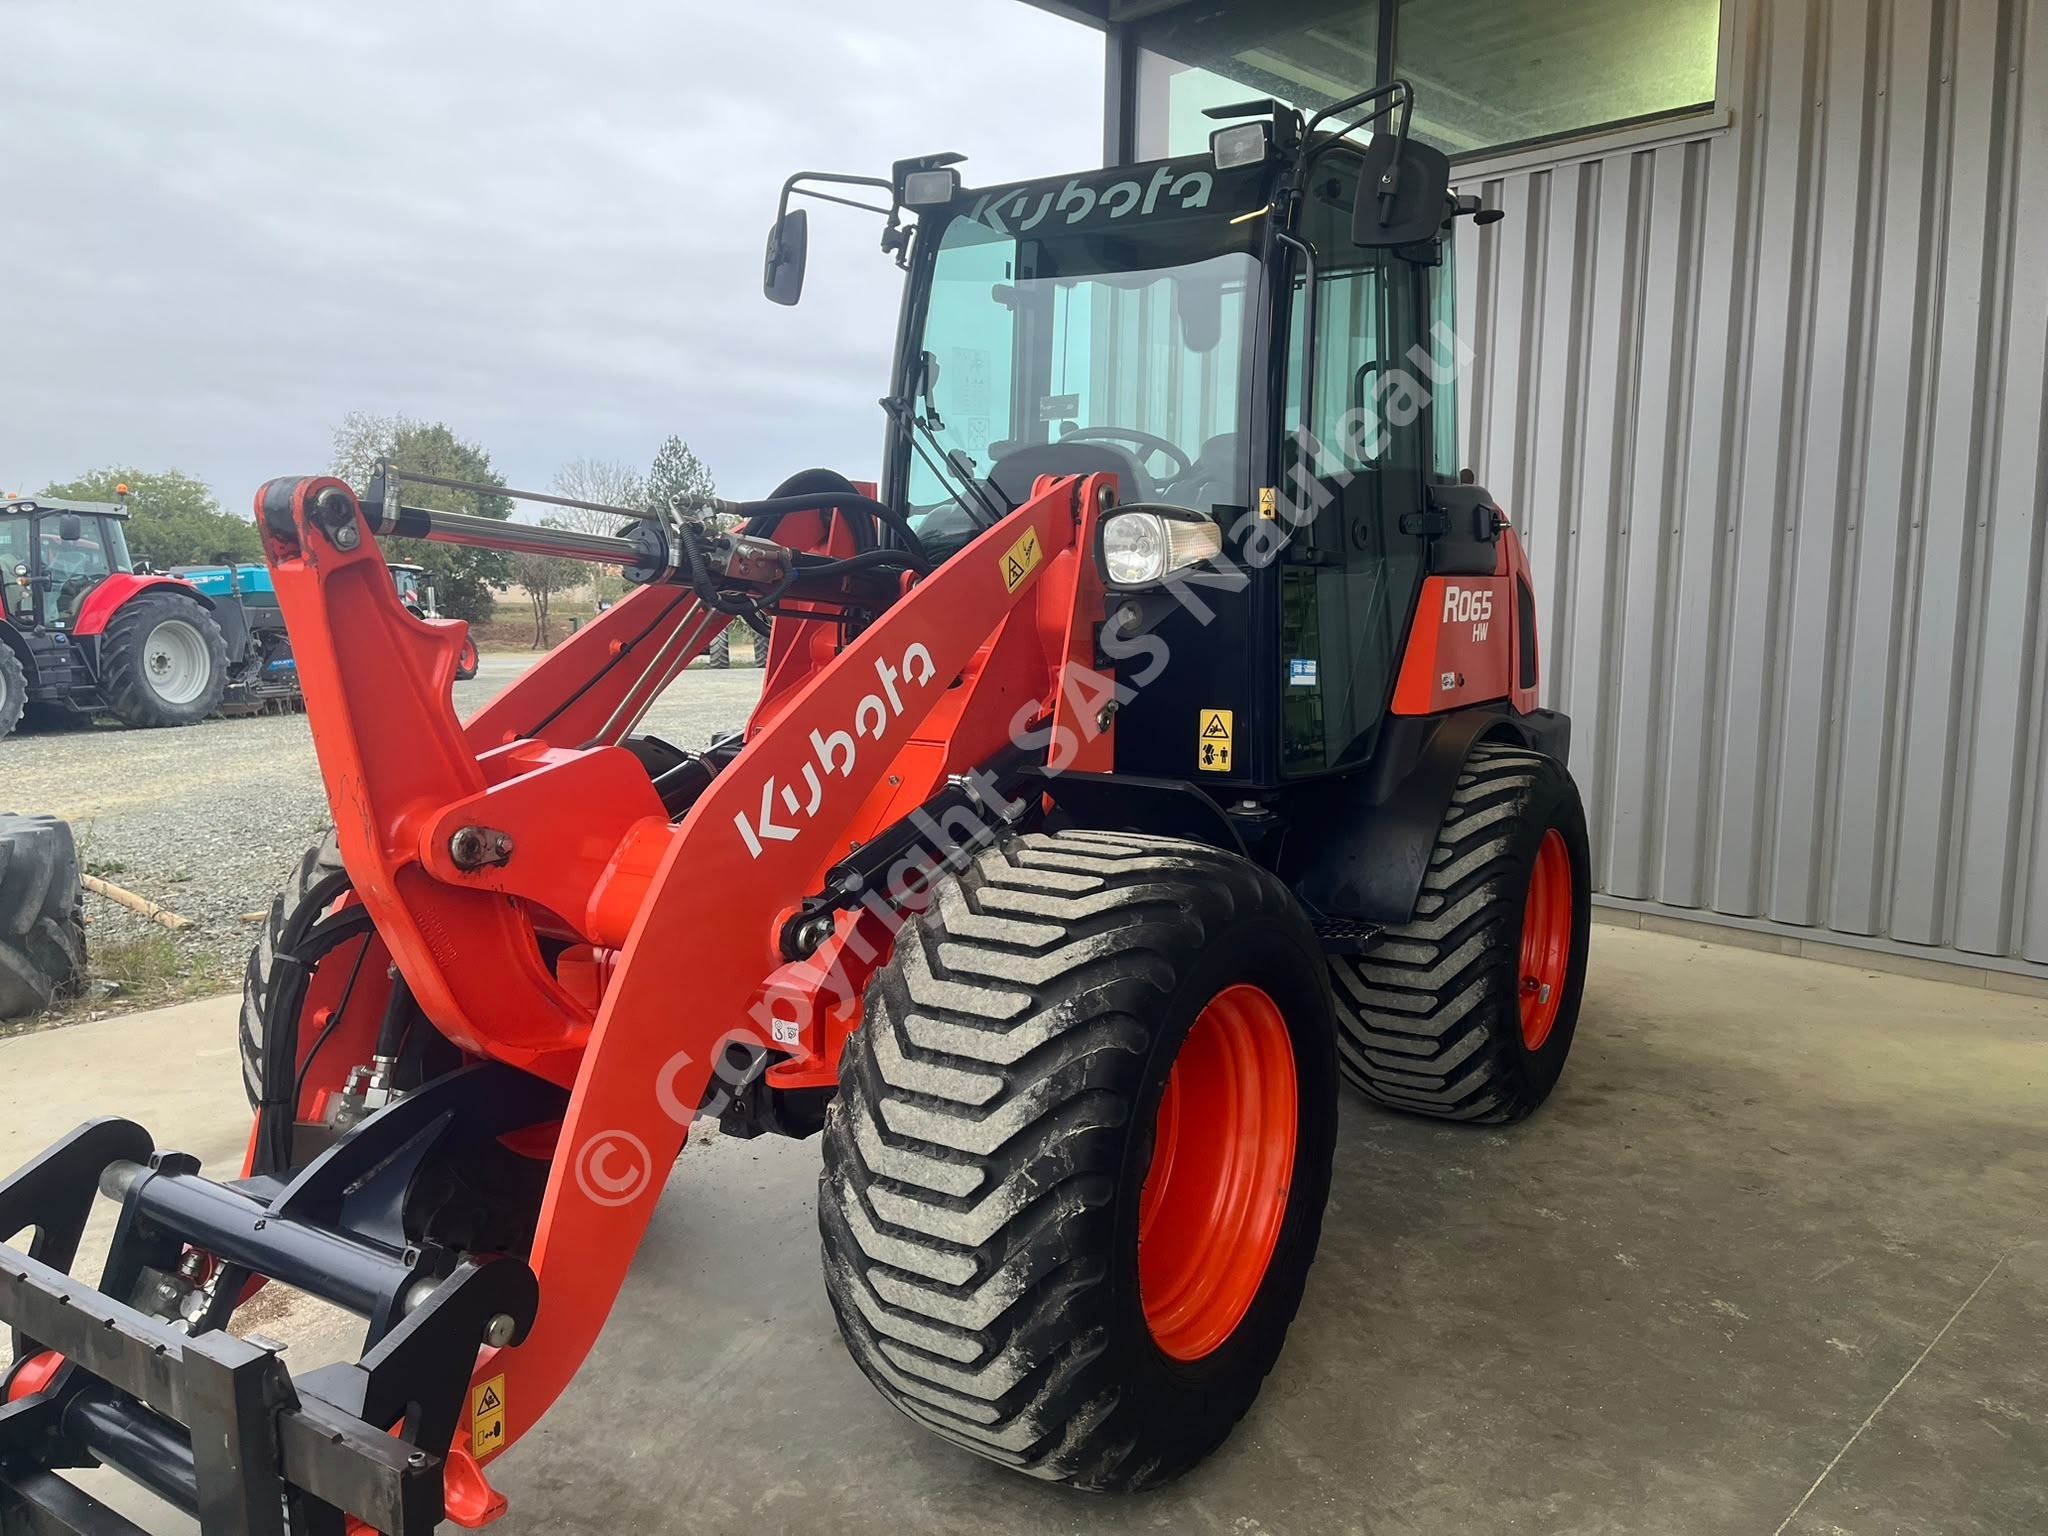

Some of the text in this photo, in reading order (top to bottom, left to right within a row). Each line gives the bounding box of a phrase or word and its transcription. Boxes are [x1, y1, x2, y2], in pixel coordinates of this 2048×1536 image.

[967, 166, 1213, 234] Kubota
[1472, 622, 1488, 642] HW
[733, 642, 936, 860] Kubota
